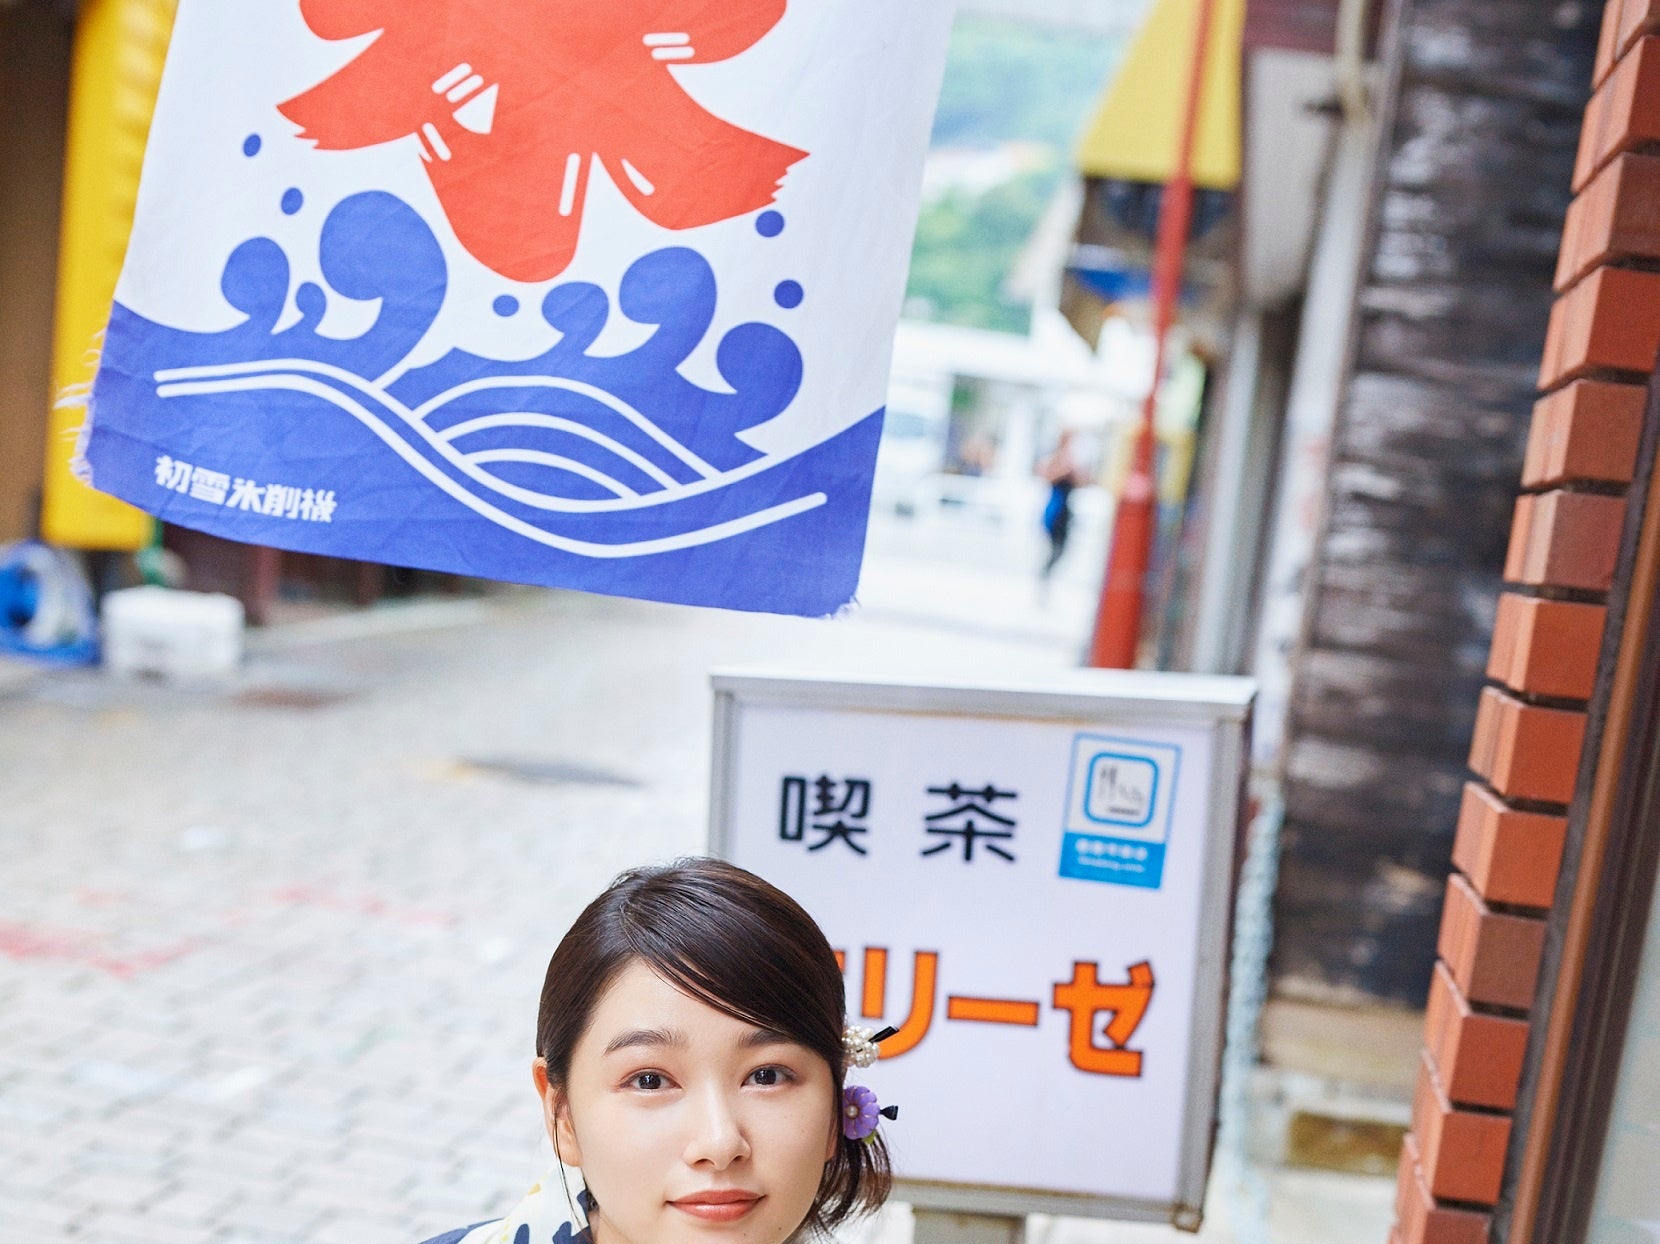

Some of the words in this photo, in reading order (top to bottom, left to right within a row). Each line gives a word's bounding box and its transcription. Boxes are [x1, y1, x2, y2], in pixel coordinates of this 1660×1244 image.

[154, 455, 337, 523] 初雪氷削機
[832, 947, 1156, 1077] リーゼ
